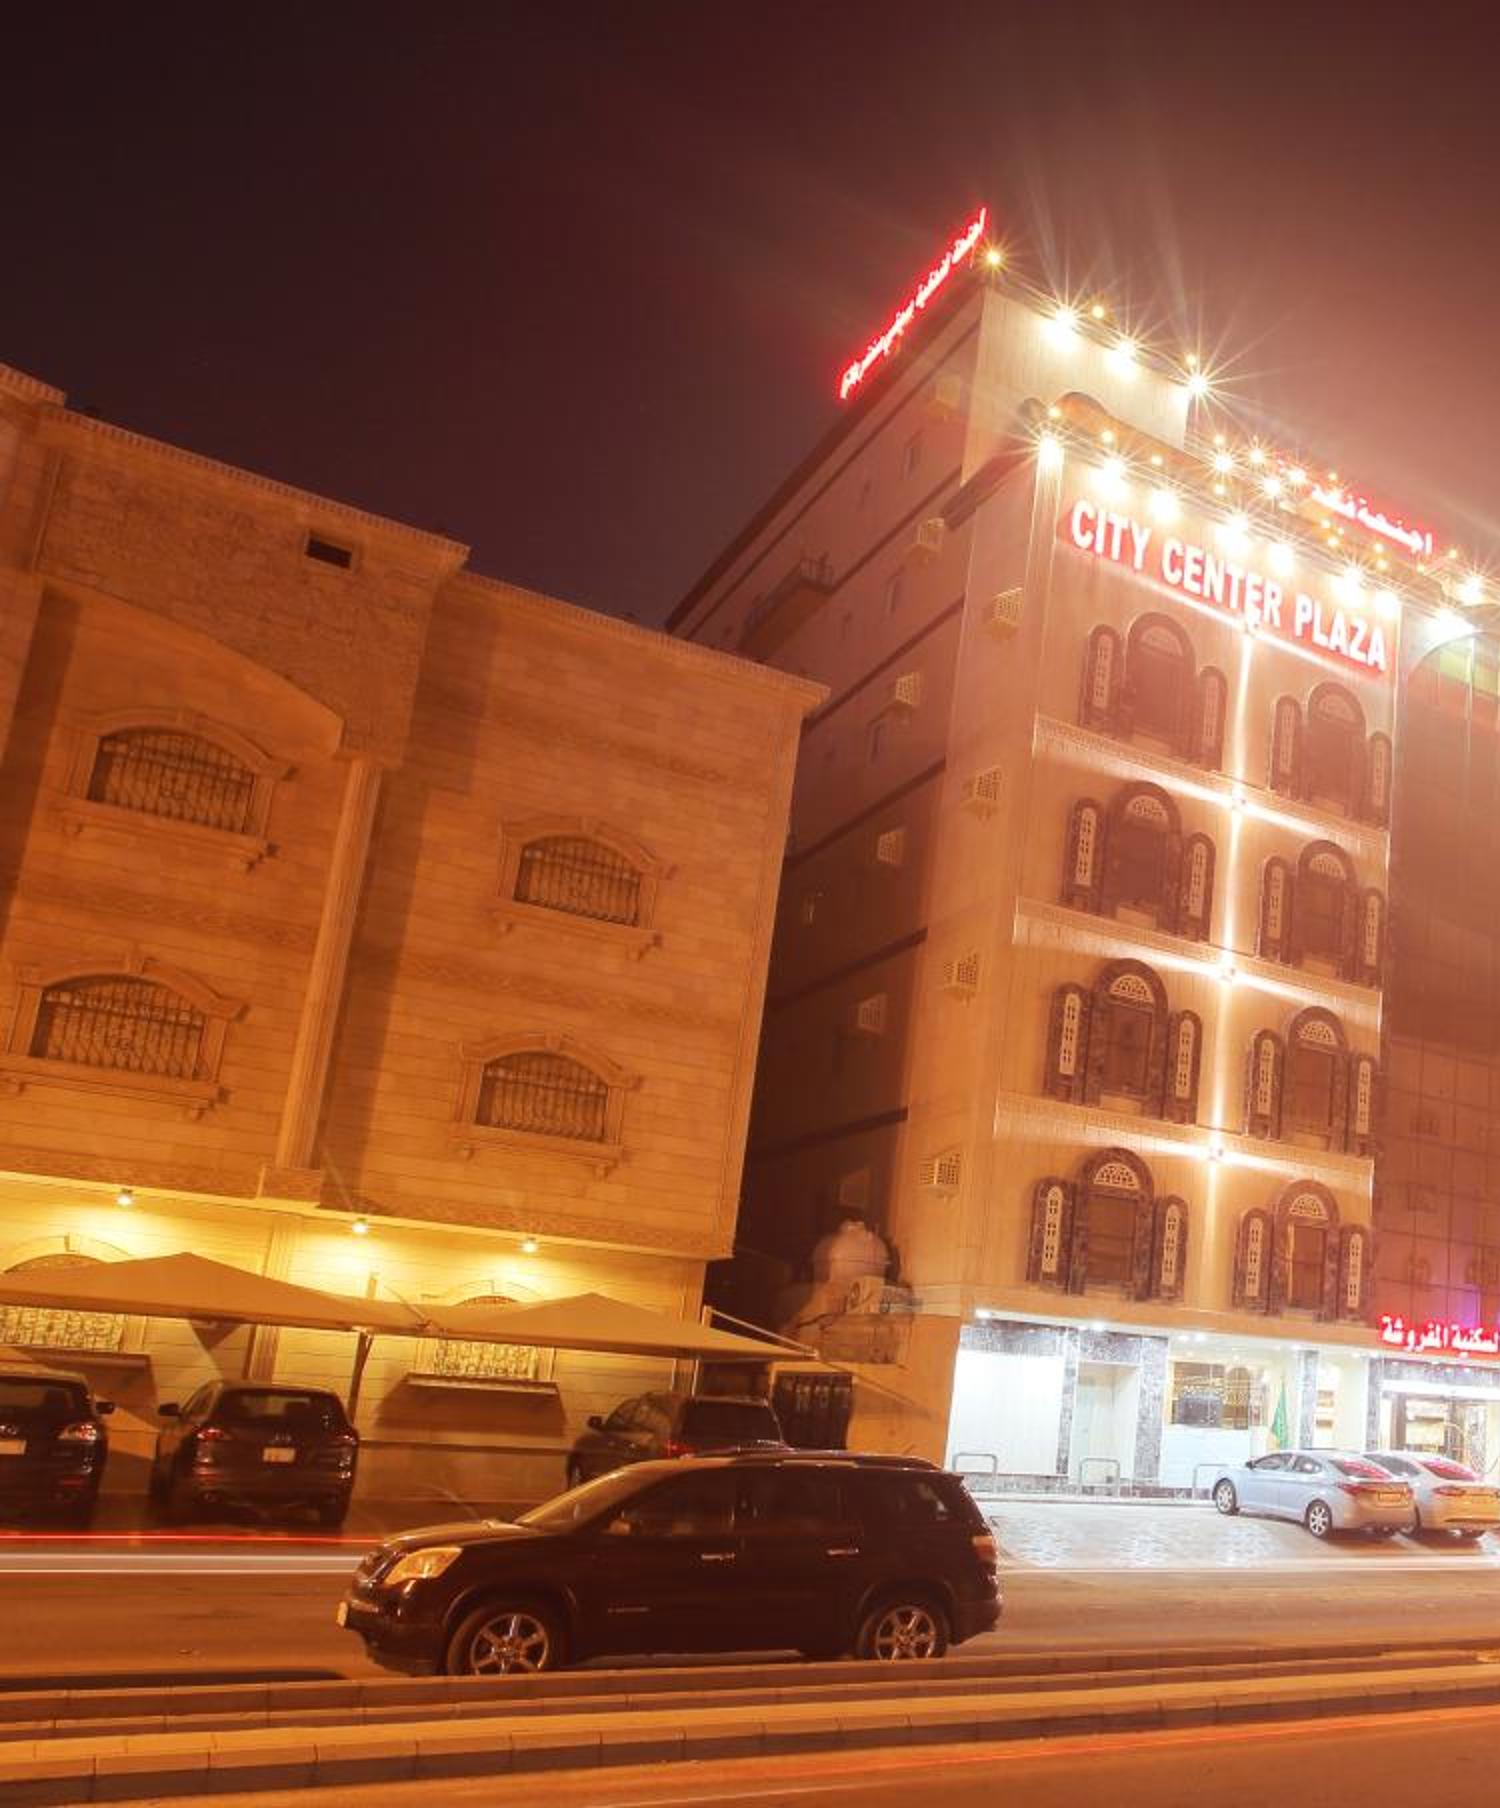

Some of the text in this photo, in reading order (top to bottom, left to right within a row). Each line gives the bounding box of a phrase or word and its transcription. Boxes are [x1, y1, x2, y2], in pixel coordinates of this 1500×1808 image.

[1070, 499, 1387, 672] CITY CENTER PLAZA
